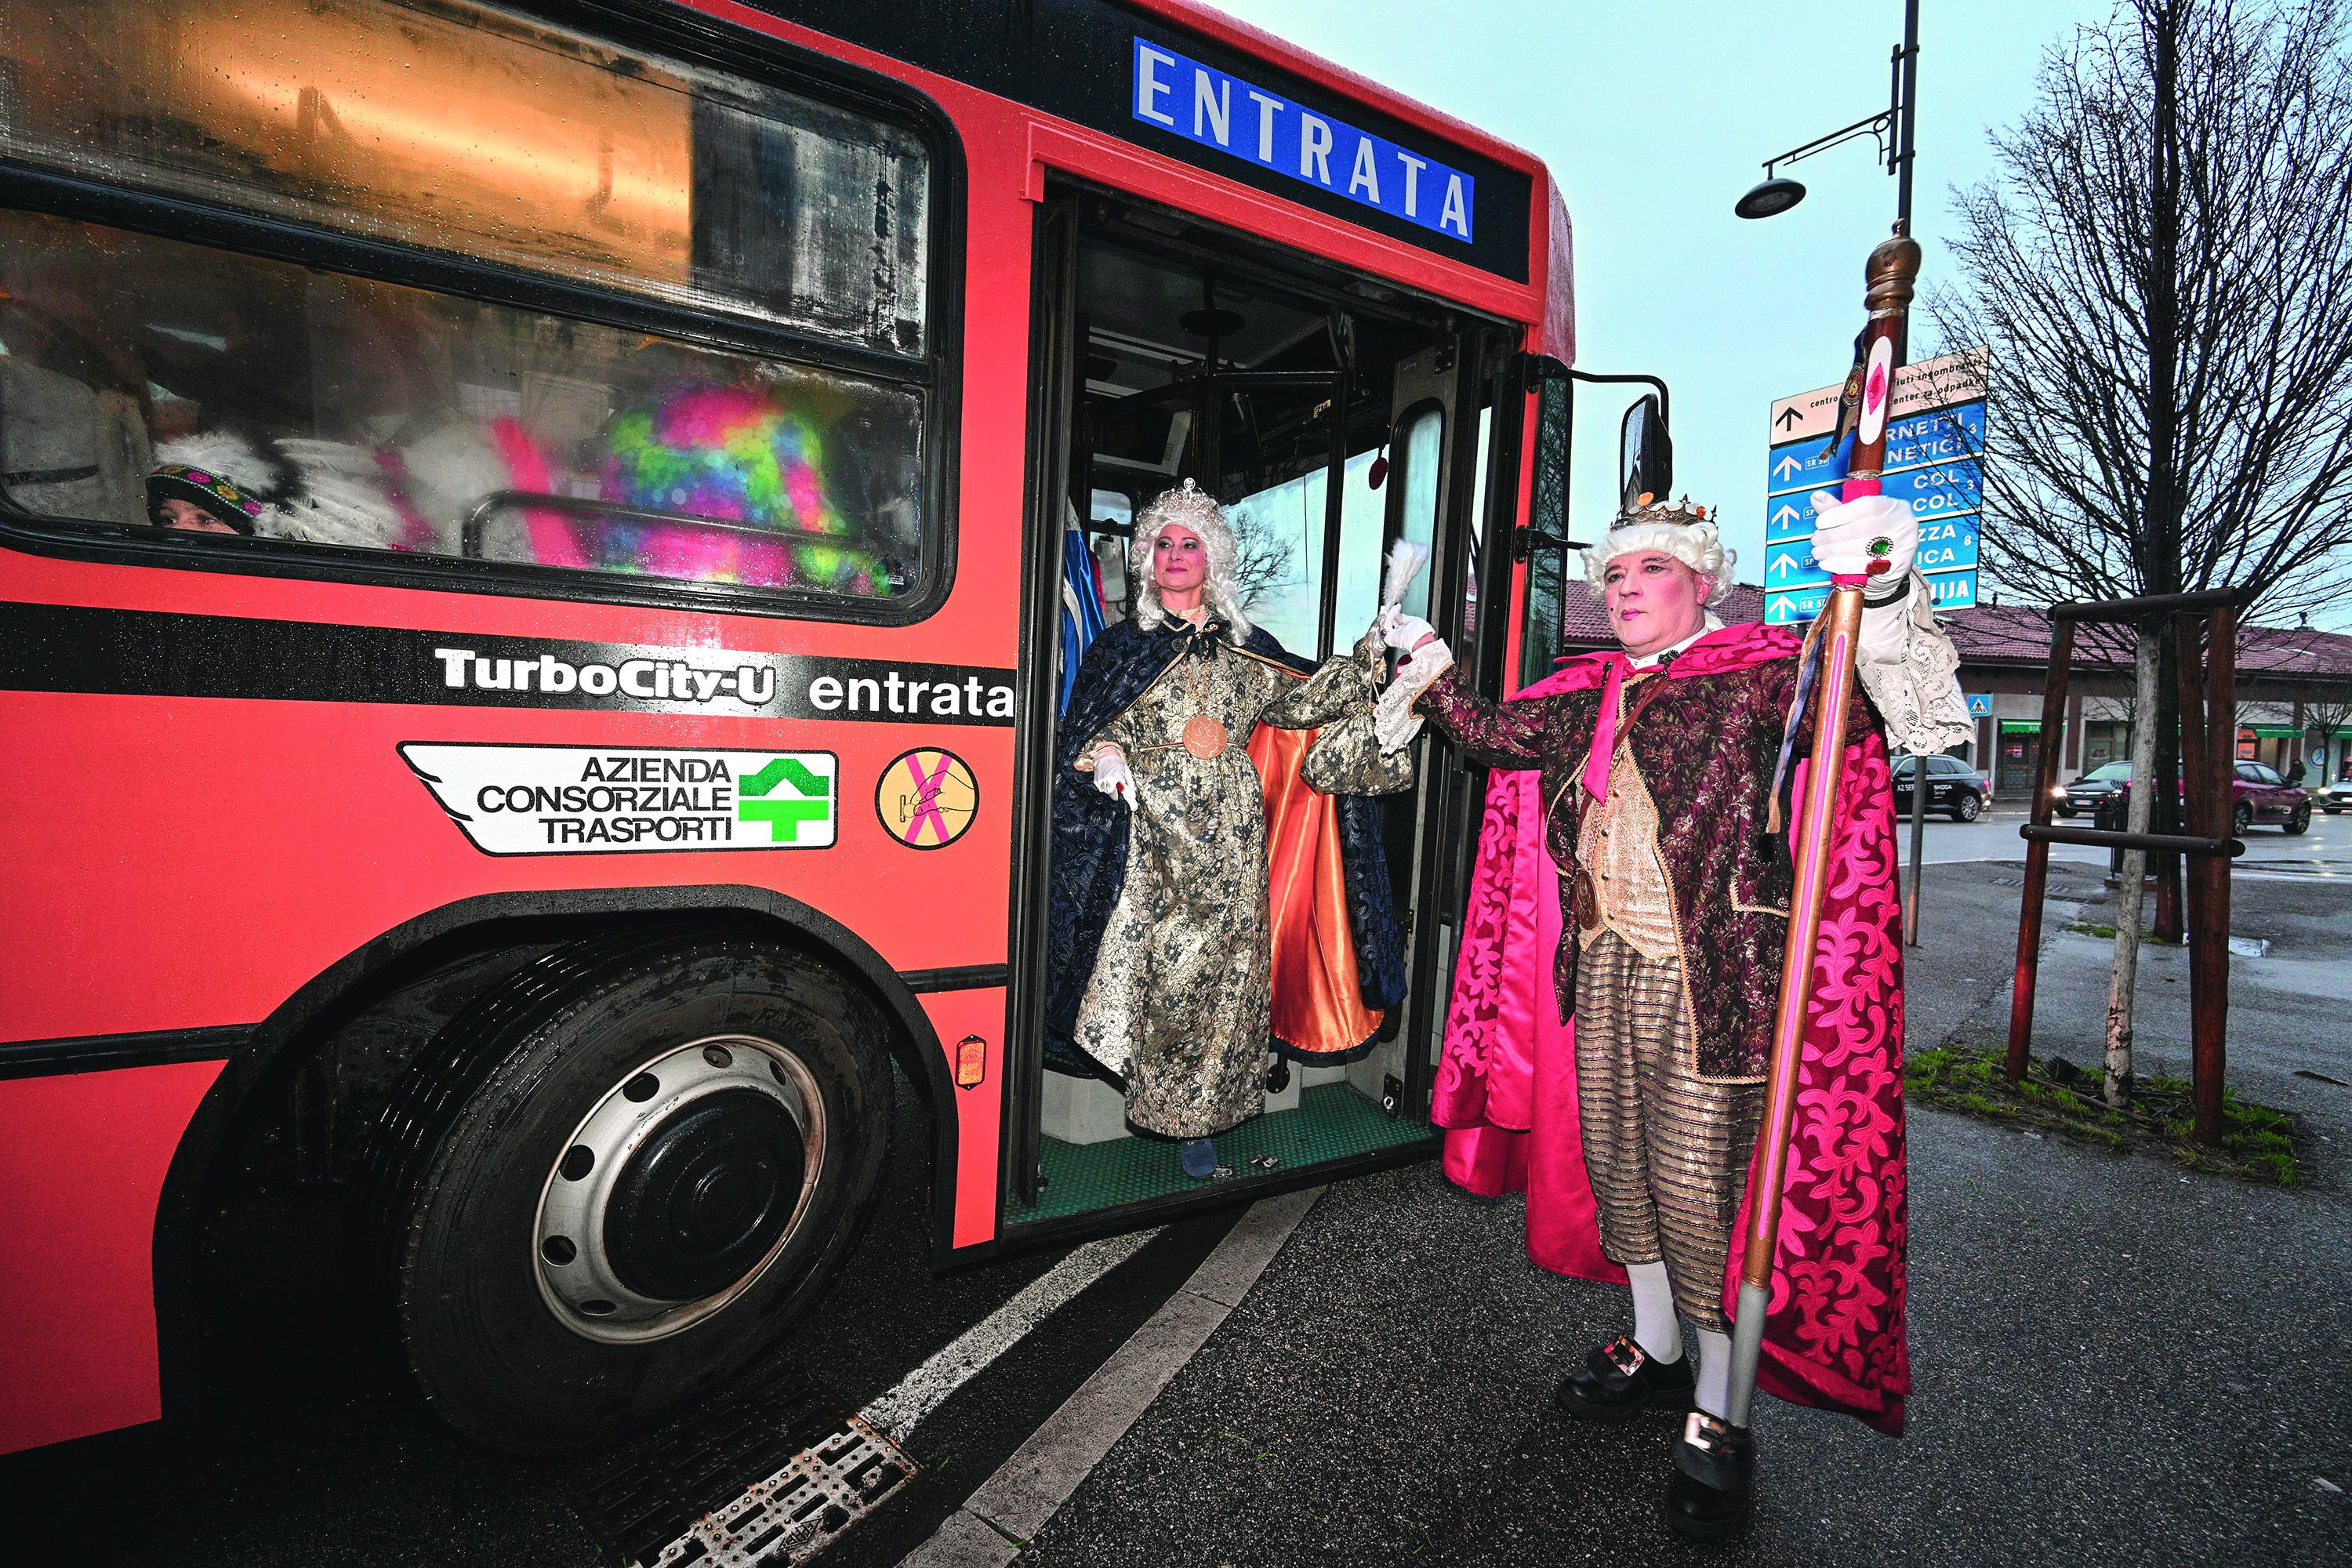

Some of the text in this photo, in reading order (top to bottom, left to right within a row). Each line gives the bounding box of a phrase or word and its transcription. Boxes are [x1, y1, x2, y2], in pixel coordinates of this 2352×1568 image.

[1138, 45, 1469, 238] ENTRATA
[1809, 395, 1838, 408] centro
[1922, 389, 1933, 398] za
[1914, 470, 1975, 490] COL 3
[1912, 493, 1958, 512] COL
[1964, 535, 1972, 546] 8
[1802, 601, 1813, 609] SR
[434, 648, 777, 705] TurboCity-U
[808, 670, 1016, 719] entrata
[580, 757, 732, 784] AZIENDA
[476, 786, 733, 814] CONSORZIALE
[538, 816, 732, 844] TRASPORTI
